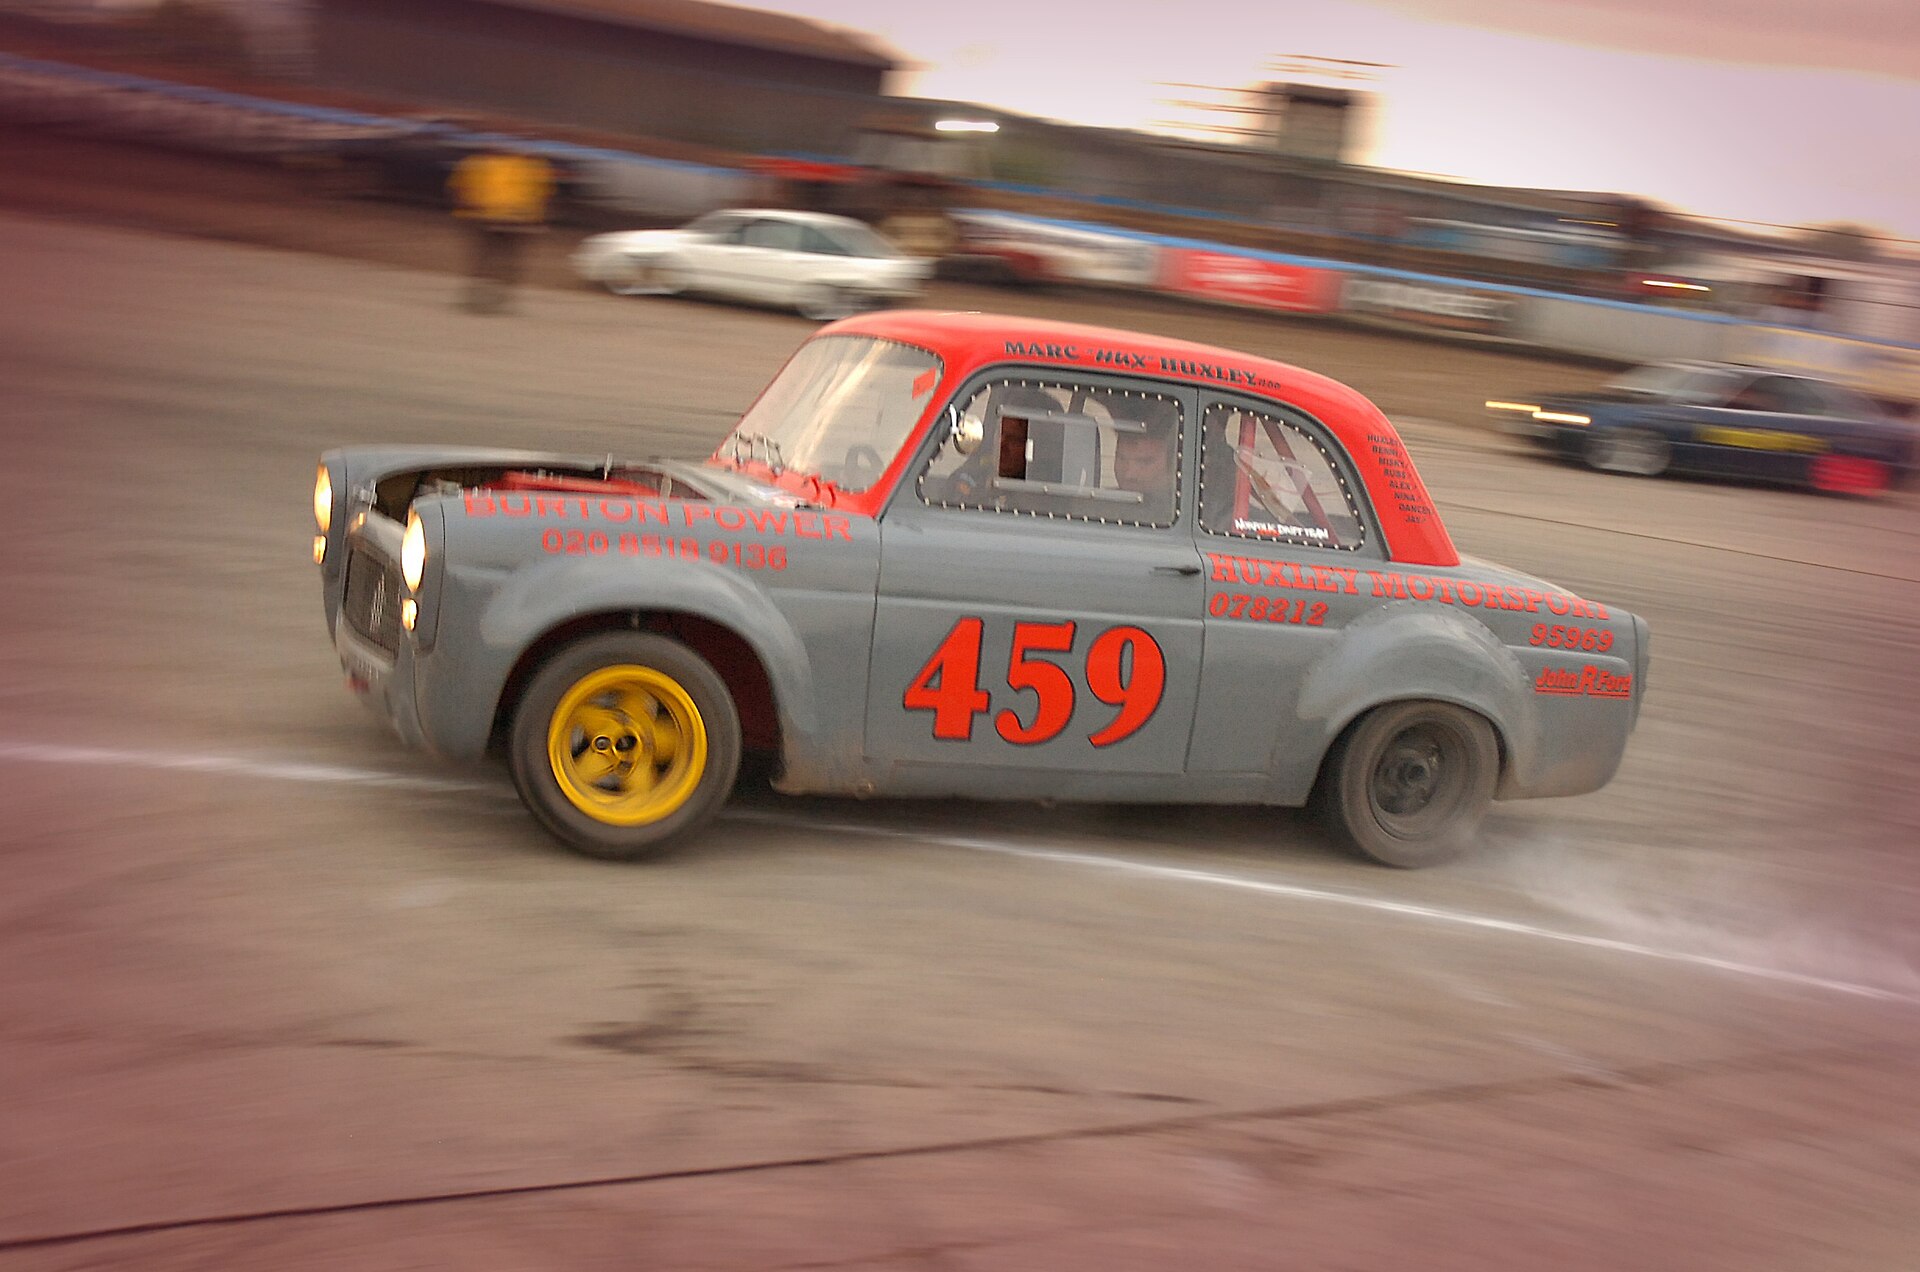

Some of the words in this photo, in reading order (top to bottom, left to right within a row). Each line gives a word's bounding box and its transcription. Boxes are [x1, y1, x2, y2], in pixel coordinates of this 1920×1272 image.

[1004, 341, 1080, 360] MARC
[1160, 356, 1257, 386] HUXLEY
[465, 495, 669, 526] BURTON
[683, 503, 853, 542] POWER
[541, 527, 609, 557] 020
[708, 540, 788, 571] 9136
[1207, 552, 1359, 595] HUXLEY
[1366, 570, 1611, 620] MOTORSPORT
[1209, 592, 1329, 626] 078212
[1528, 623, 1615, 652] 95969
[903, 616, 1167, 749] 459
[1535, 664, 1578, 688] John
[1579, 664, 1599, 694] R
[1597, 670, 1633, 692] Ford
